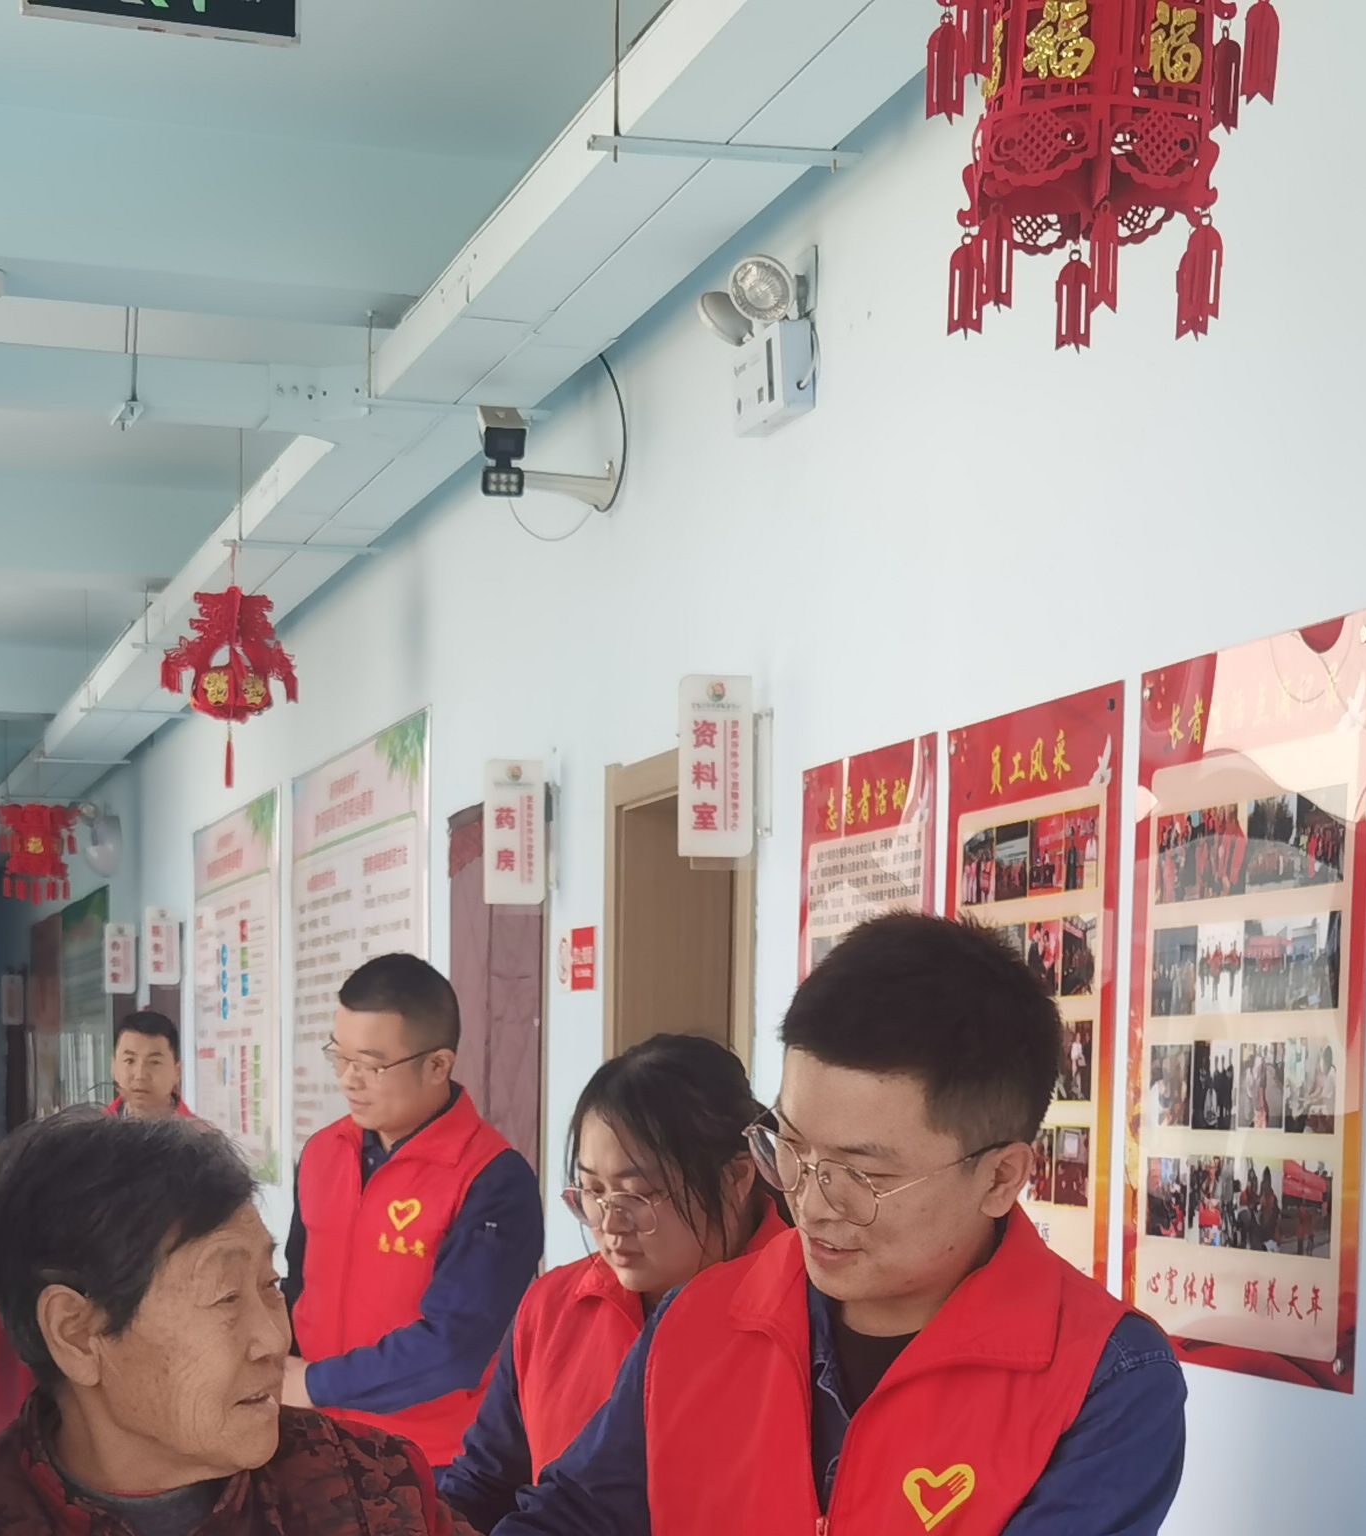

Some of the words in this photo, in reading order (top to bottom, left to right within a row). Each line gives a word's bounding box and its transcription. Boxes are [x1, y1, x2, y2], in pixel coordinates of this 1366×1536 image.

[691, 719, 719, 831] 资料室
[989, 729, 1072, 796] 员工风采
[824, 779, 908, 832] 志愿者活动
[494, 807, 517, 872] 药房
[1146, 1266, 1218, 1311] 心宽体健
[1243, 1277, 1324, 1327] 颐养天年
